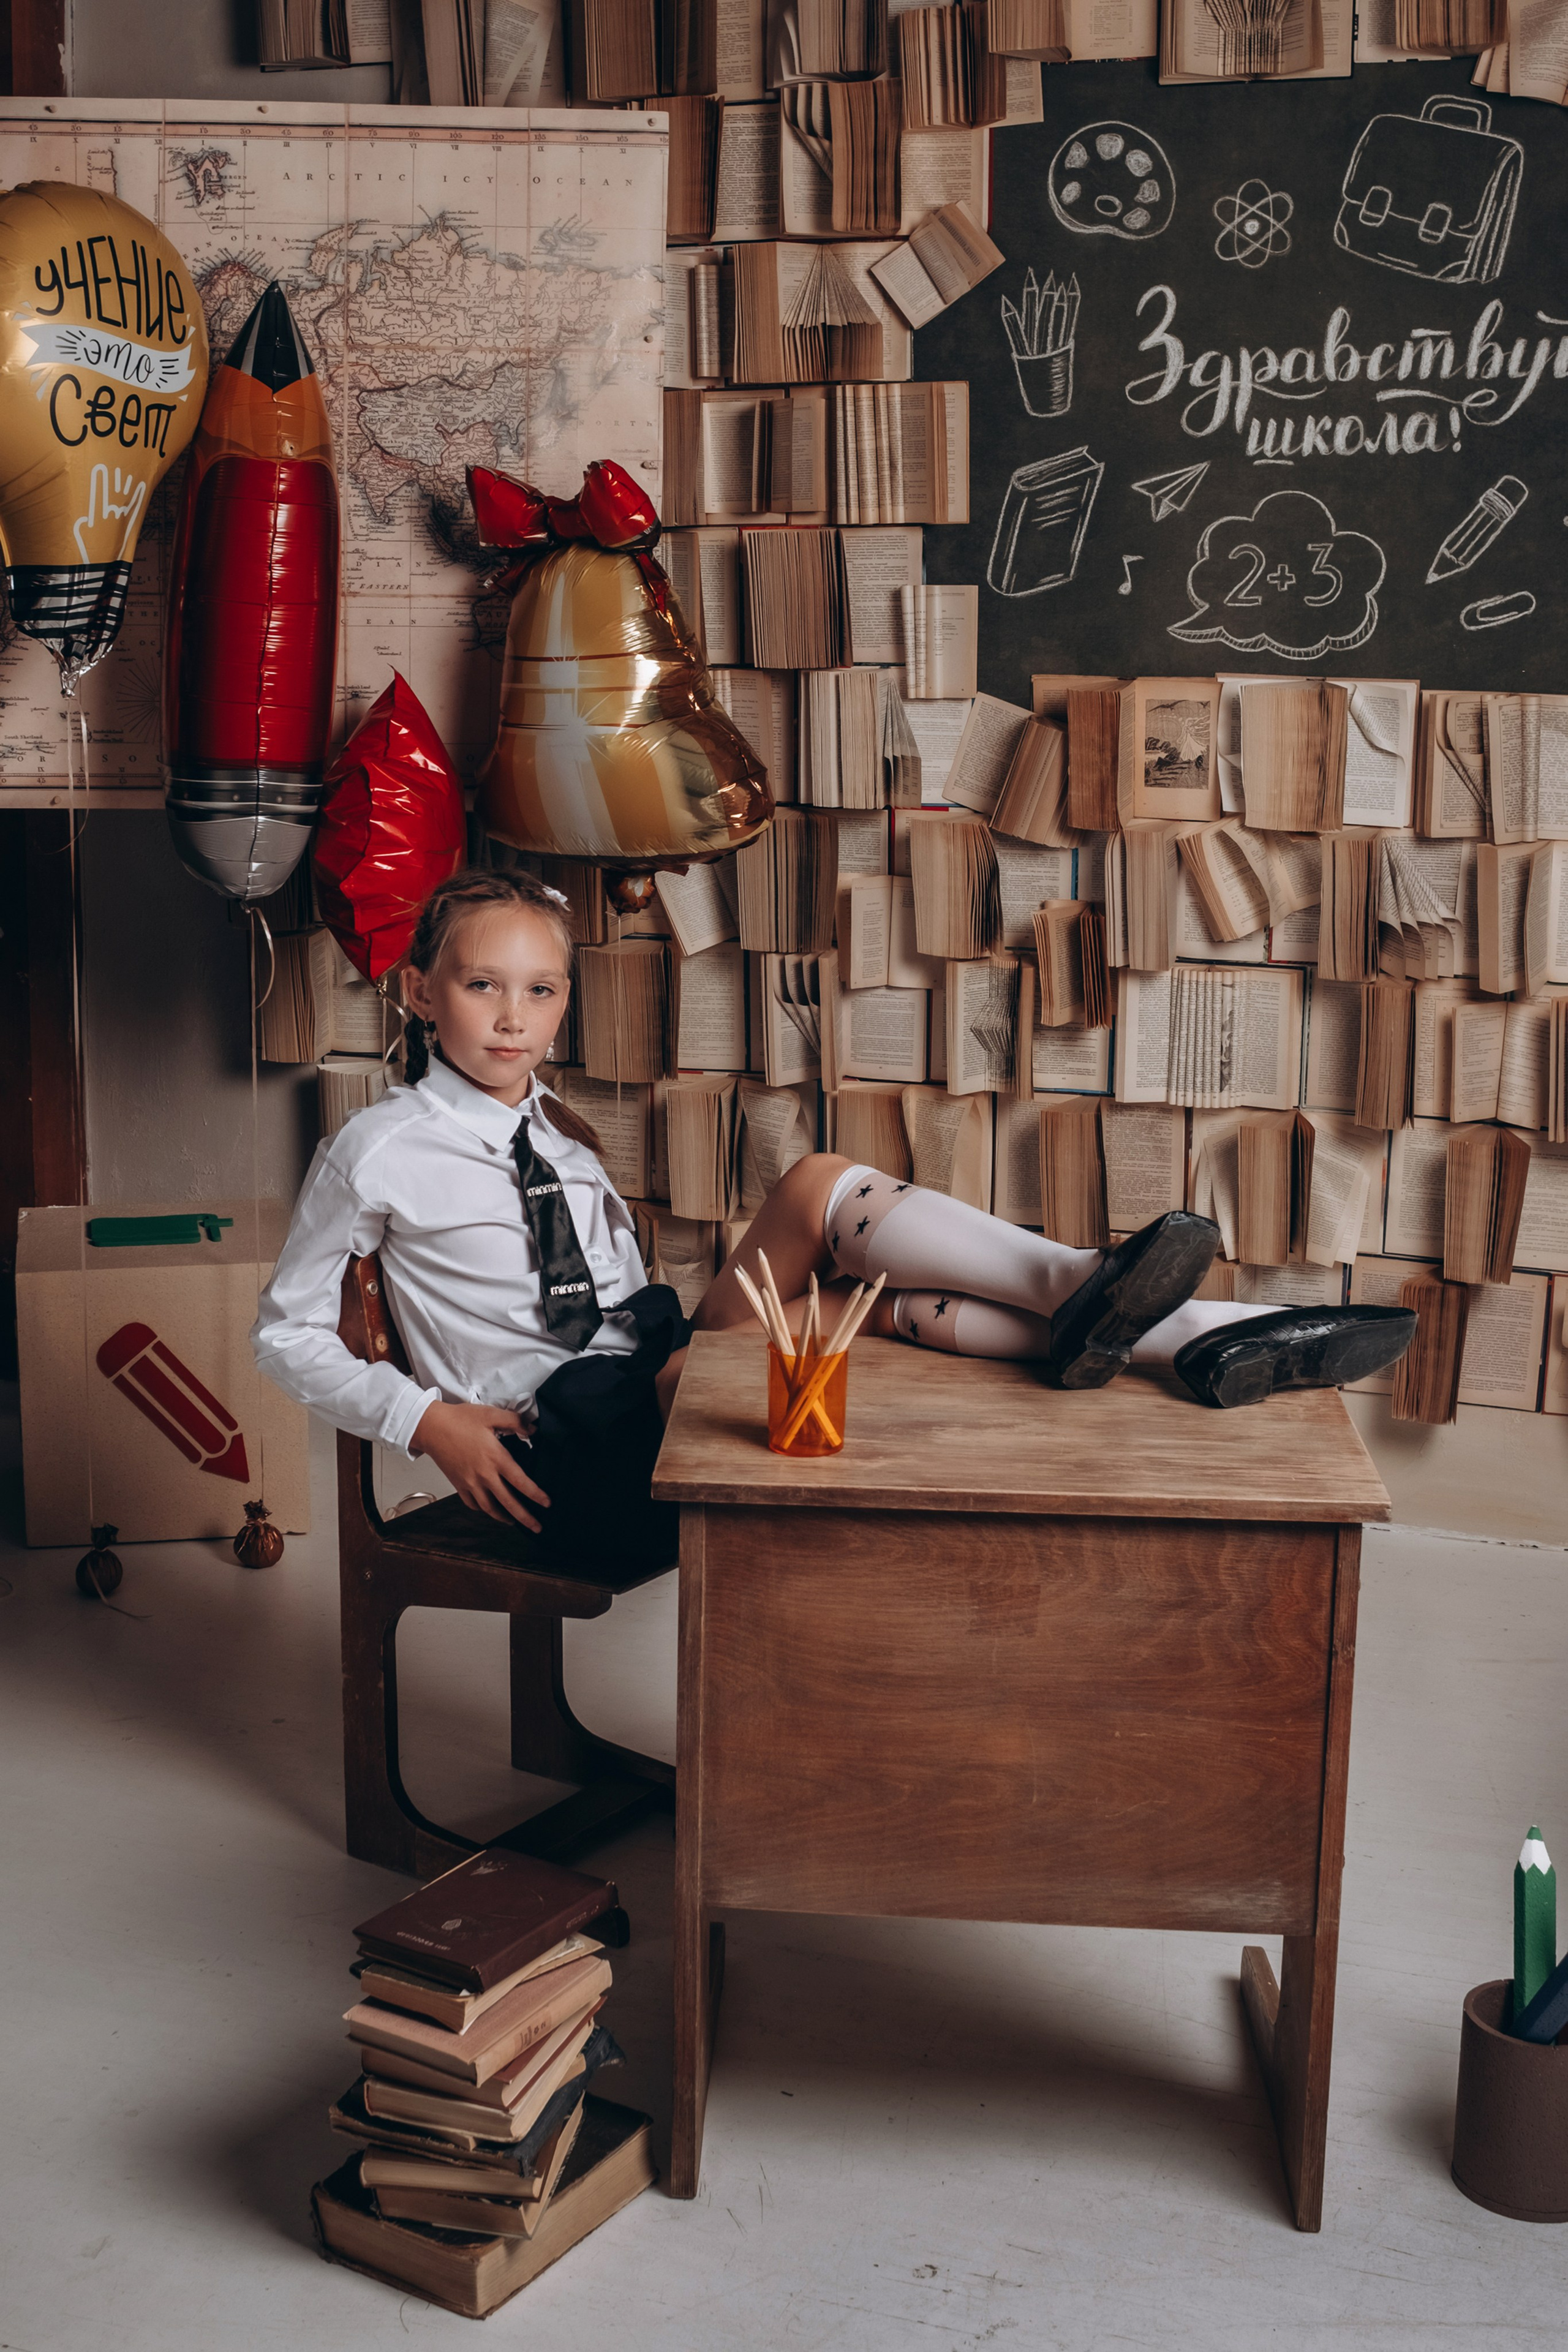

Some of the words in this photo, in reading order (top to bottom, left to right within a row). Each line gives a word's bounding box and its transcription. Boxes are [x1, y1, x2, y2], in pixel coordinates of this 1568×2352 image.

[283, 172, 405, 181] ARCTIC
[443, 175, 494, 184] ICY
[533, 176, 633, 186] OCEAN
[84, 339, 155, 383] это
[49, 373, 177, 459] Свет
[1246, 405, 1461, 466] школа!
